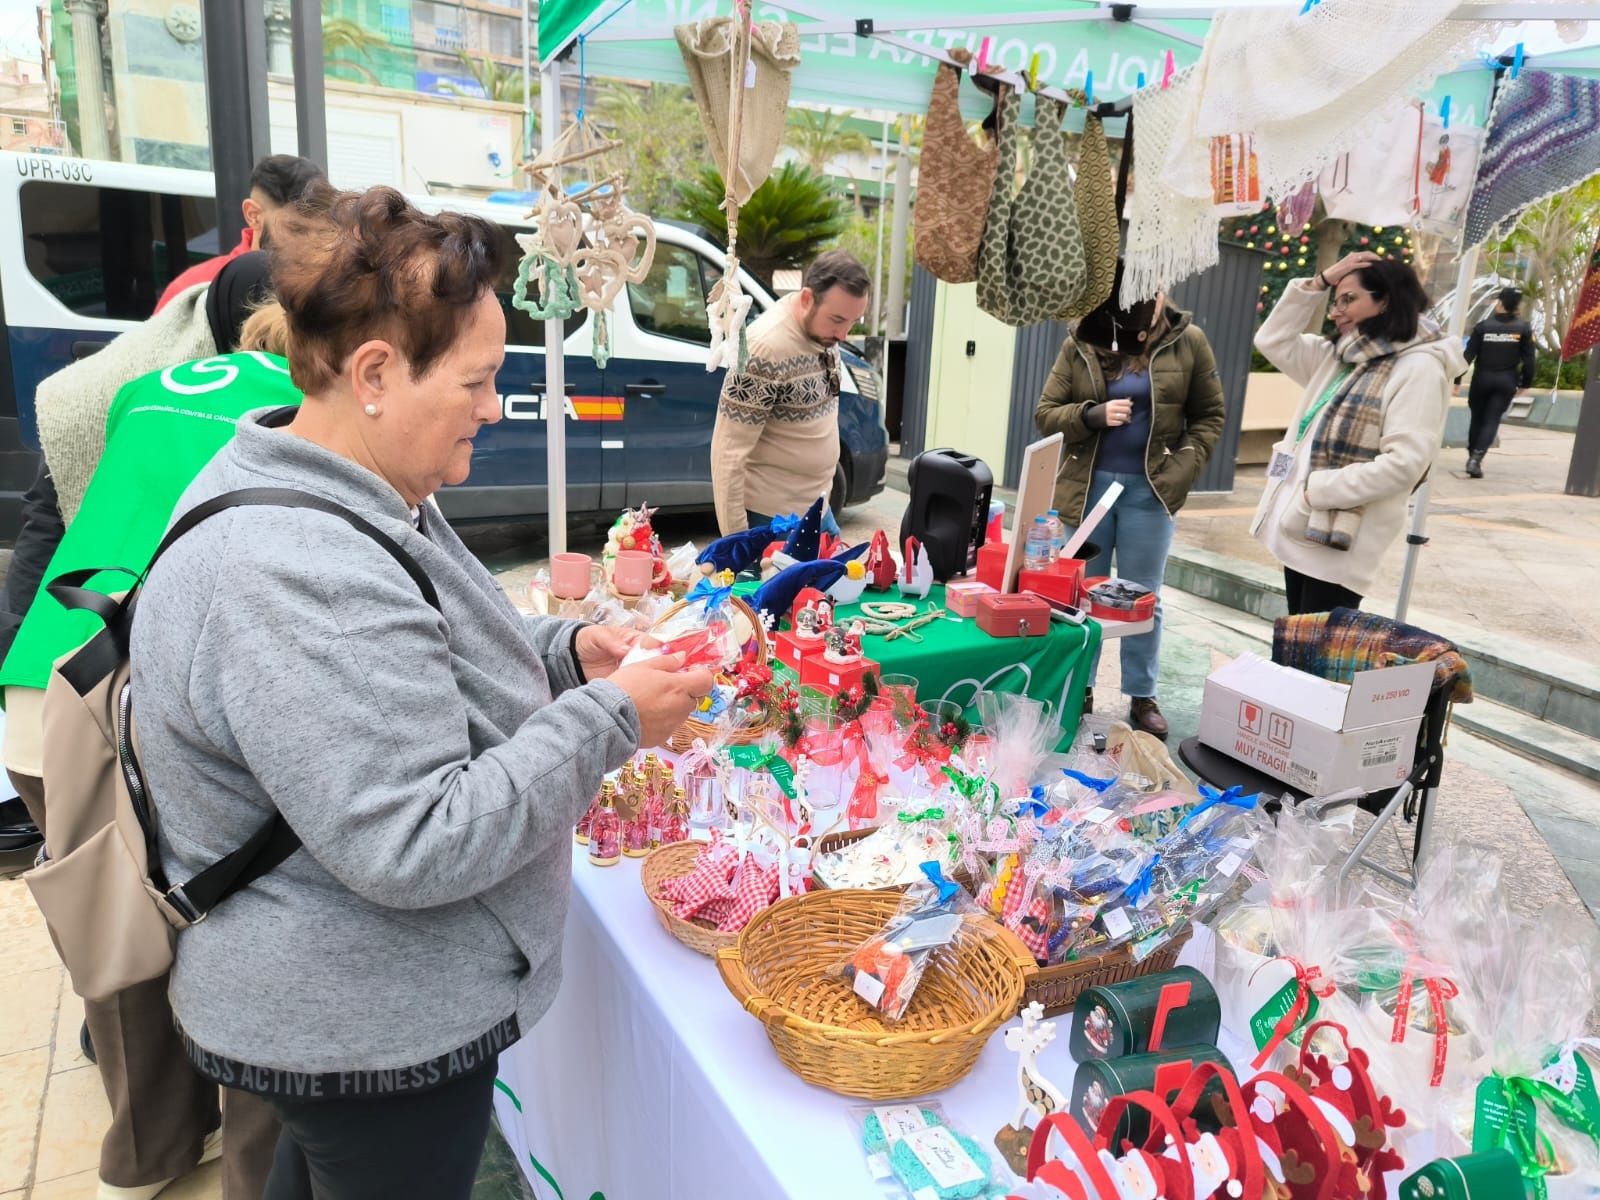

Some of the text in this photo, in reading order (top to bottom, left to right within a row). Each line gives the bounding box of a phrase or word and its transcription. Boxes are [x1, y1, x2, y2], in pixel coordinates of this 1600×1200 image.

[16, 157, 93, 182] UPR-03C
[1234, 739, 1256, 758] MUY
[241, 1062, 324, 1097] ACTIVE
[339, 1058, 441, 1095] FITNESS
[447, 1019, 516, 1077] ACTIVE
